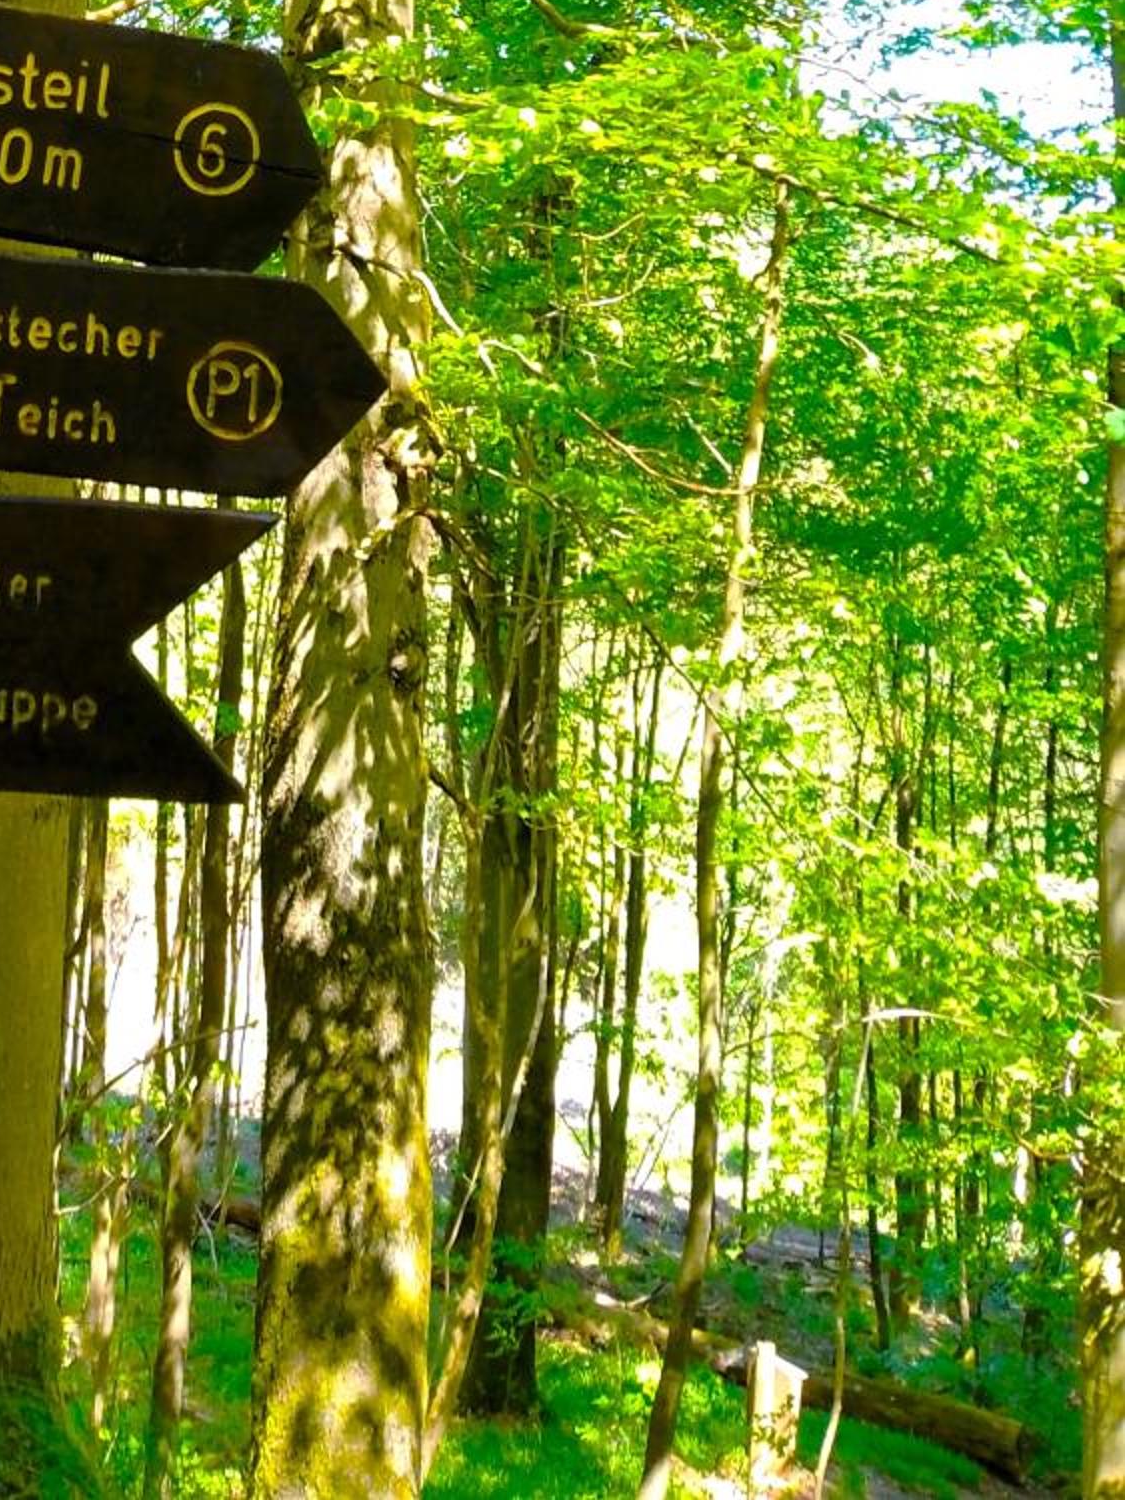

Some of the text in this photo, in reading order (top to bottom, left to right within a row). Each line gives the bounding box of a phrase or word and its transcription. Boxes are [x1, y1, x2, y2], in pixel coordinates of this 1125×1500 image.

[43, 144, 83, 191] m
[196, 122, 229, 178] 6
[205, 361, 262, 421] P1
